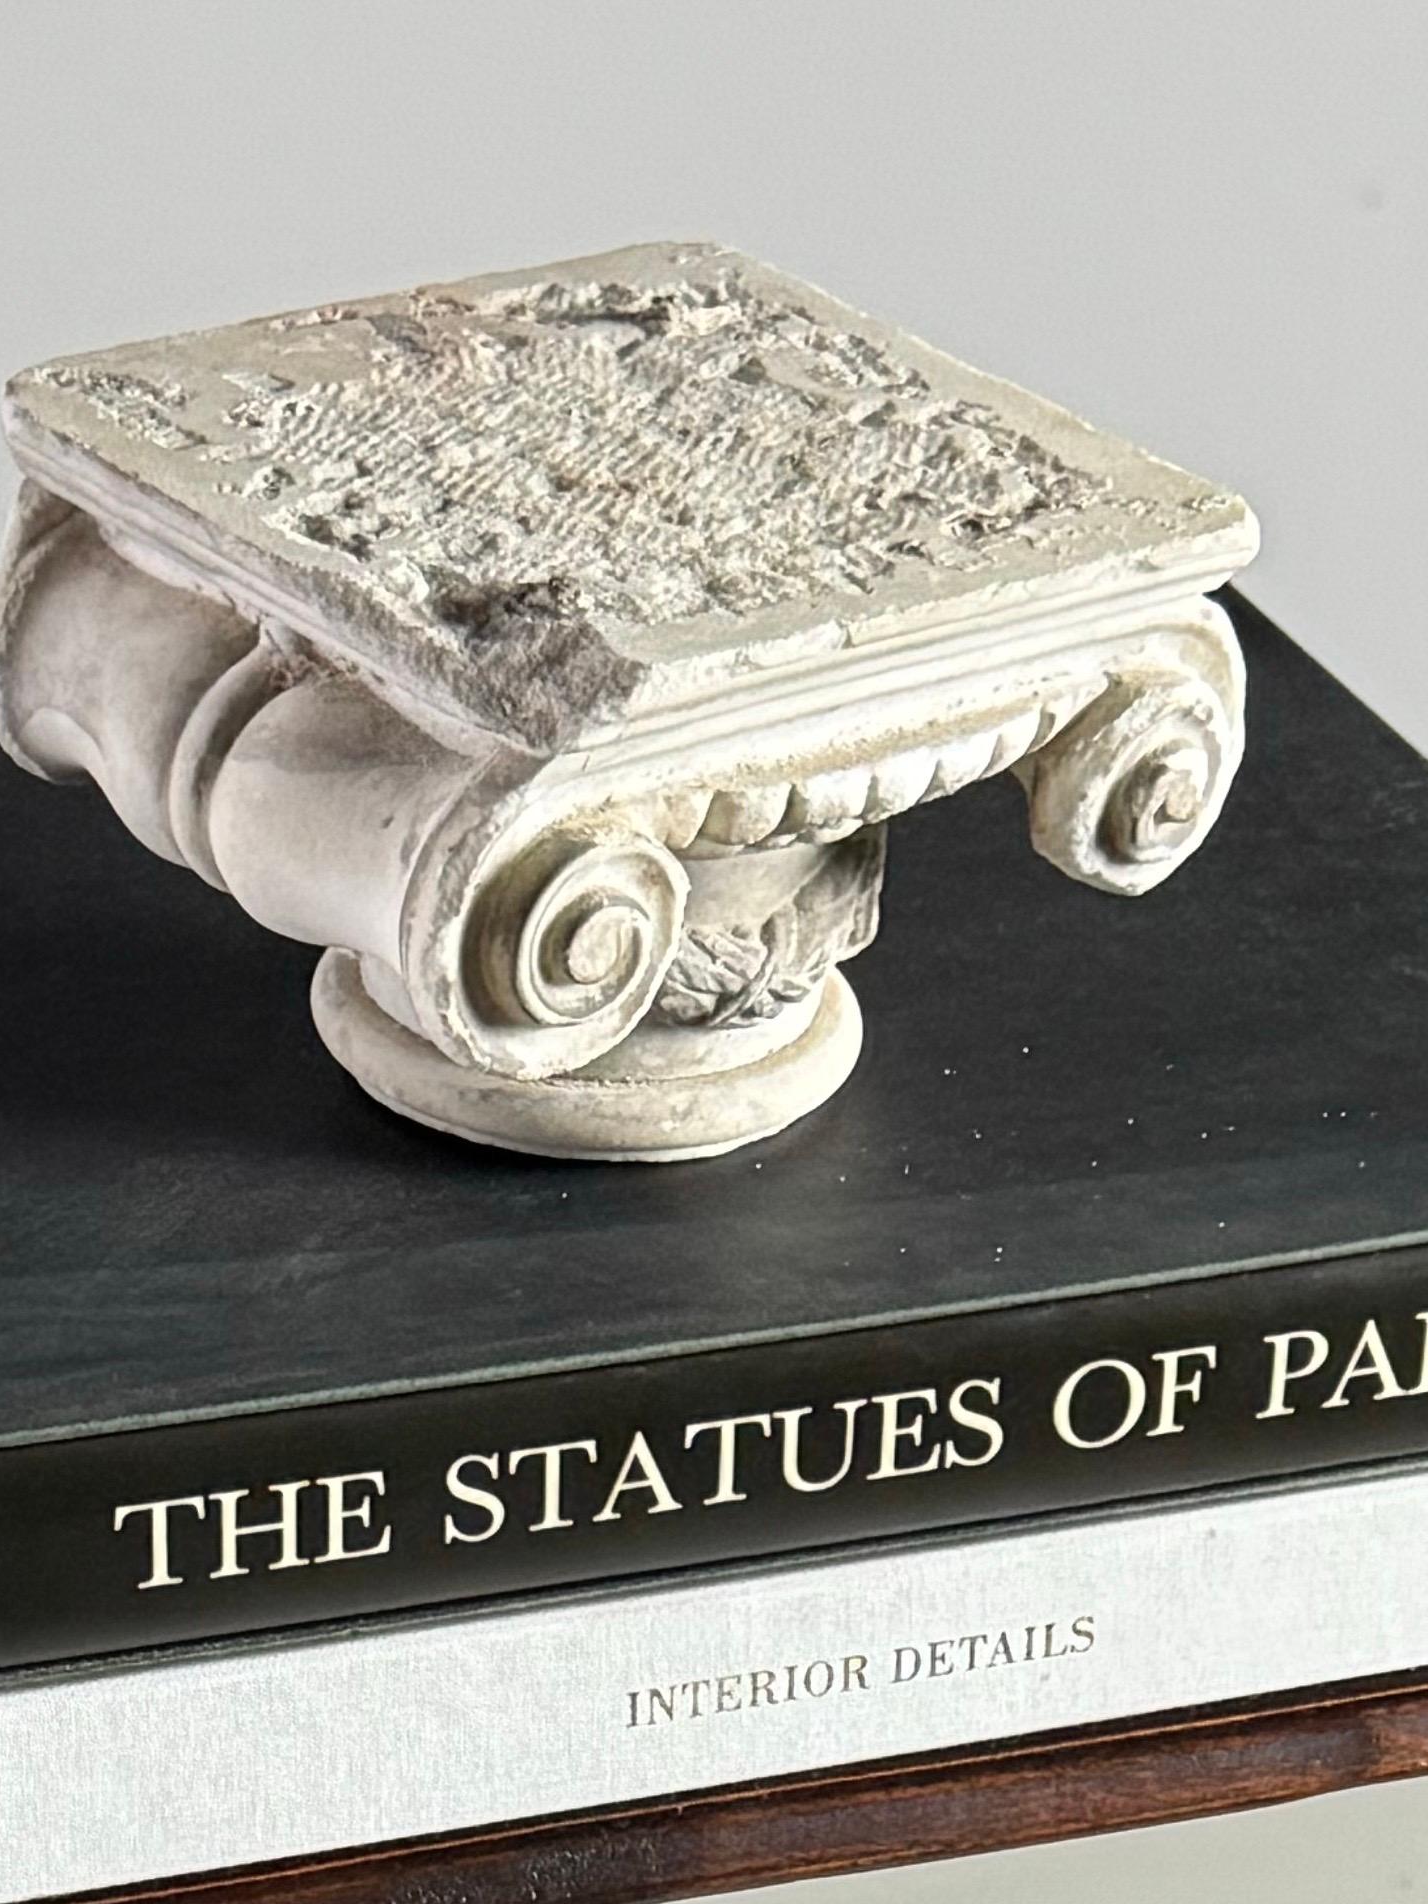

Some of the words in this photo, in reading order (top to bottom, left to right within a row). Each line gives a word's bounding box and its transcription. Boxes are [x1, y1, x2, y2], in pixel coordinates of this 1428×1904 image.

[113, 1470, 391, 1590] THE
[444, 1377, 1004, 1545] STATUES
[1052, 1345, 1217, 1449] OF
[625, 1654, 870, 1728] INTERIOR
[891, 1615, 1097, 1684] DETAILS
